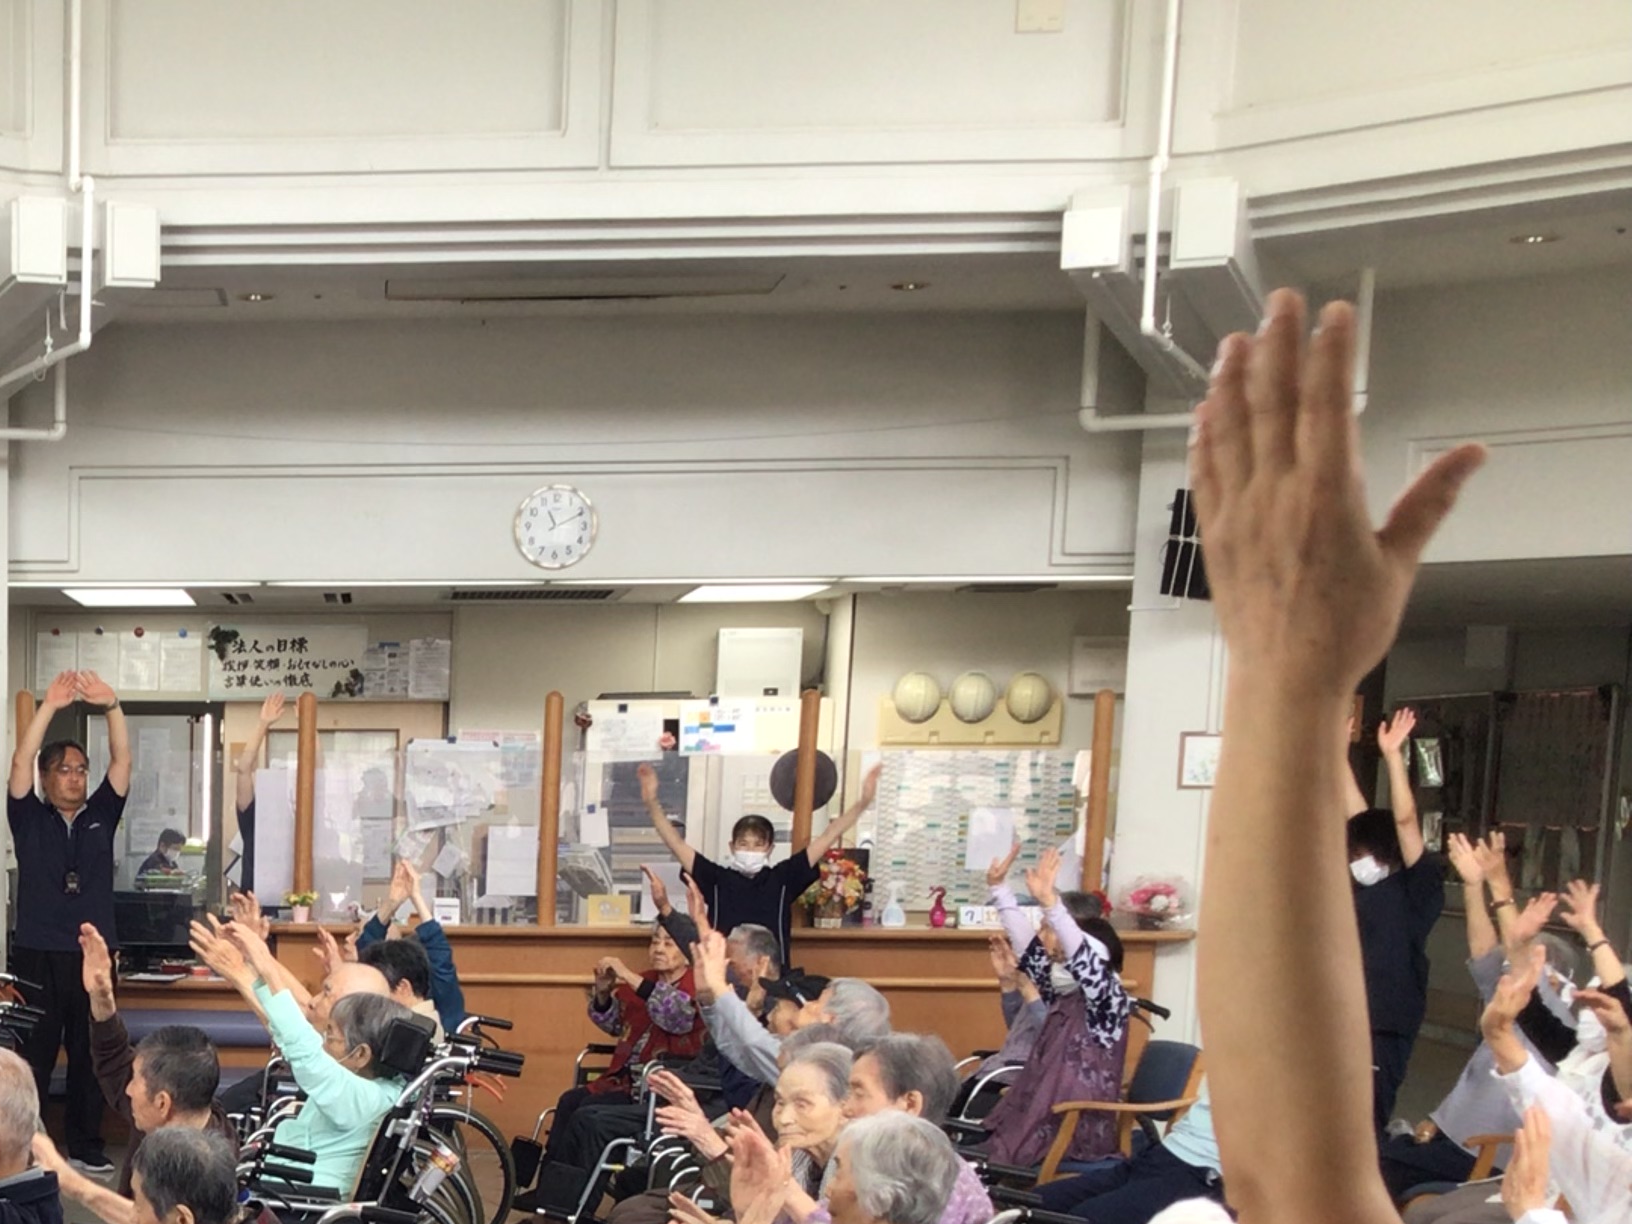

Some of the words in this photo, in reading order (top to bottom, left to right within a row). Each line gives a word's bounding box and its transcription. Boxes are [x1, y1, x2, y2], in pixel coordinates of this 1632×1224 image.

[232, 637, 308, 654] 法人の目標
